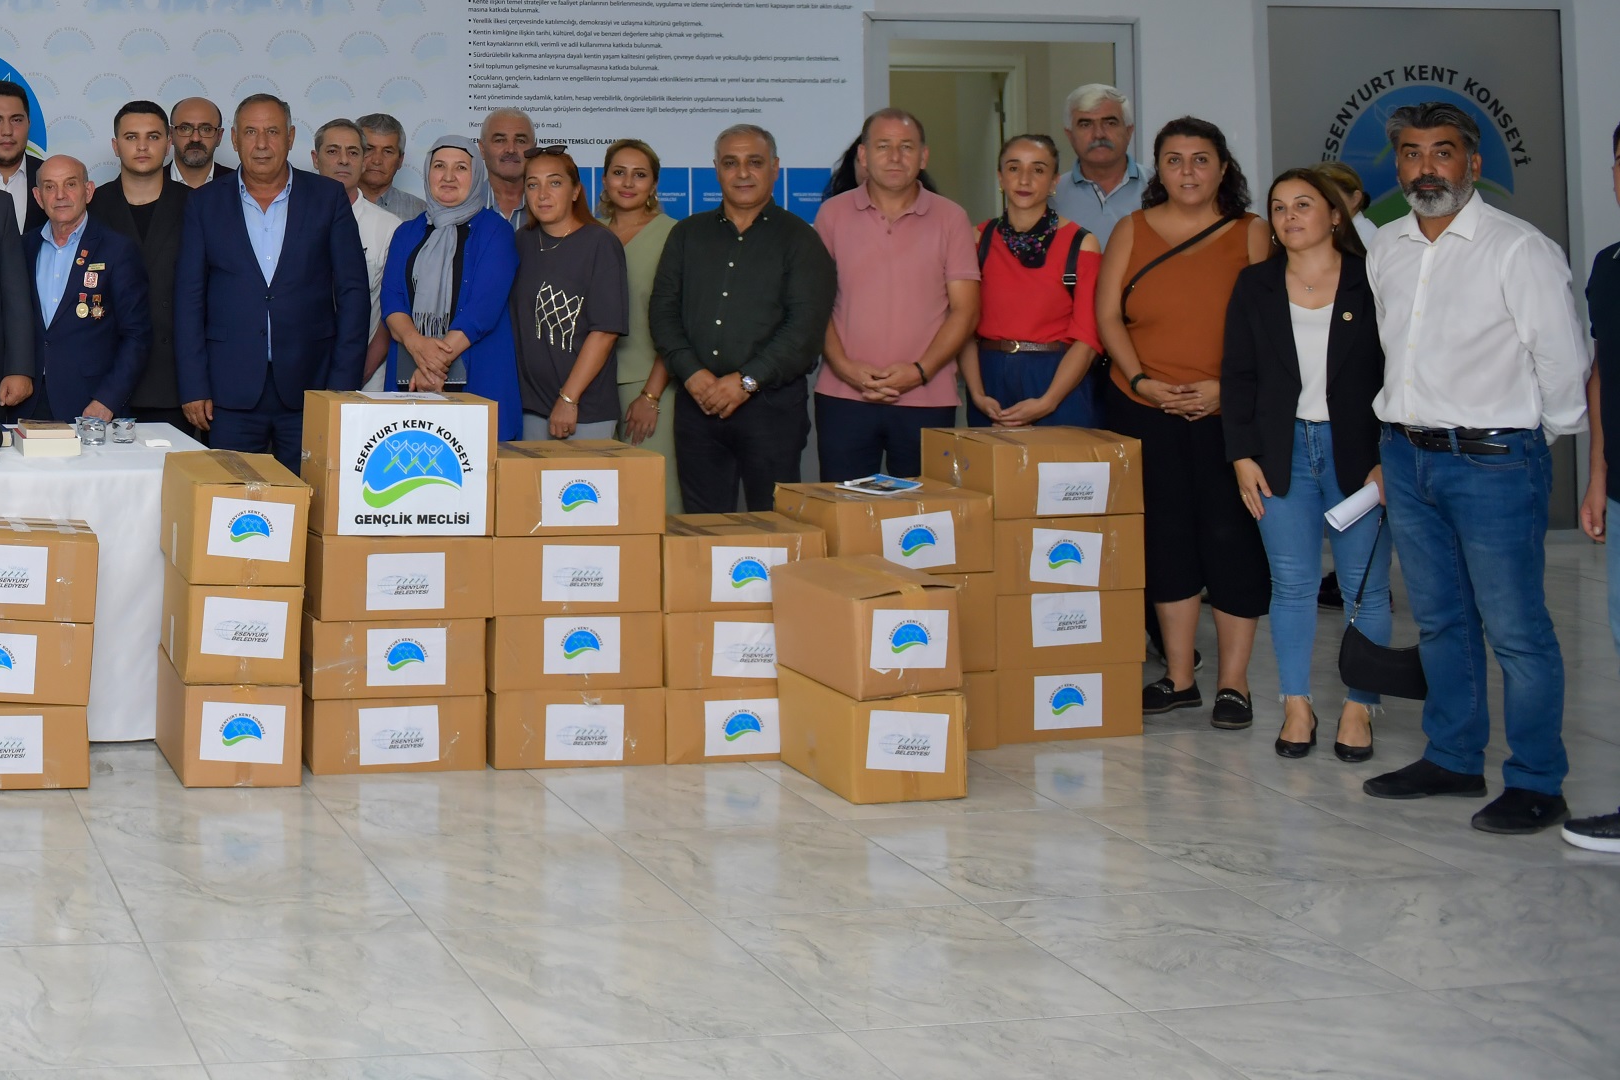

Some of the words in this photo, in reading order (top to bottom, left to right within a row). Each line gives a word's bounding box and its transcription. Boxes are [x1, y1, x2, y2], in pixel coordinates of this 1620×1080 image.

[1322, 69, 1396, 163] ESENYURT
[1403, 64, 1459, 86] KENT
[1463, 77, 1532, 168] KONSEYİ
[354, 422, 398, 473] ESENYURT
[402, 419, 434, 429] KENT
[436, 426, 473, 474] KONSEYİ
[354, 512, 412, 527] GENÇLİK
[417, 512, 470, 525] MECLİSİ
